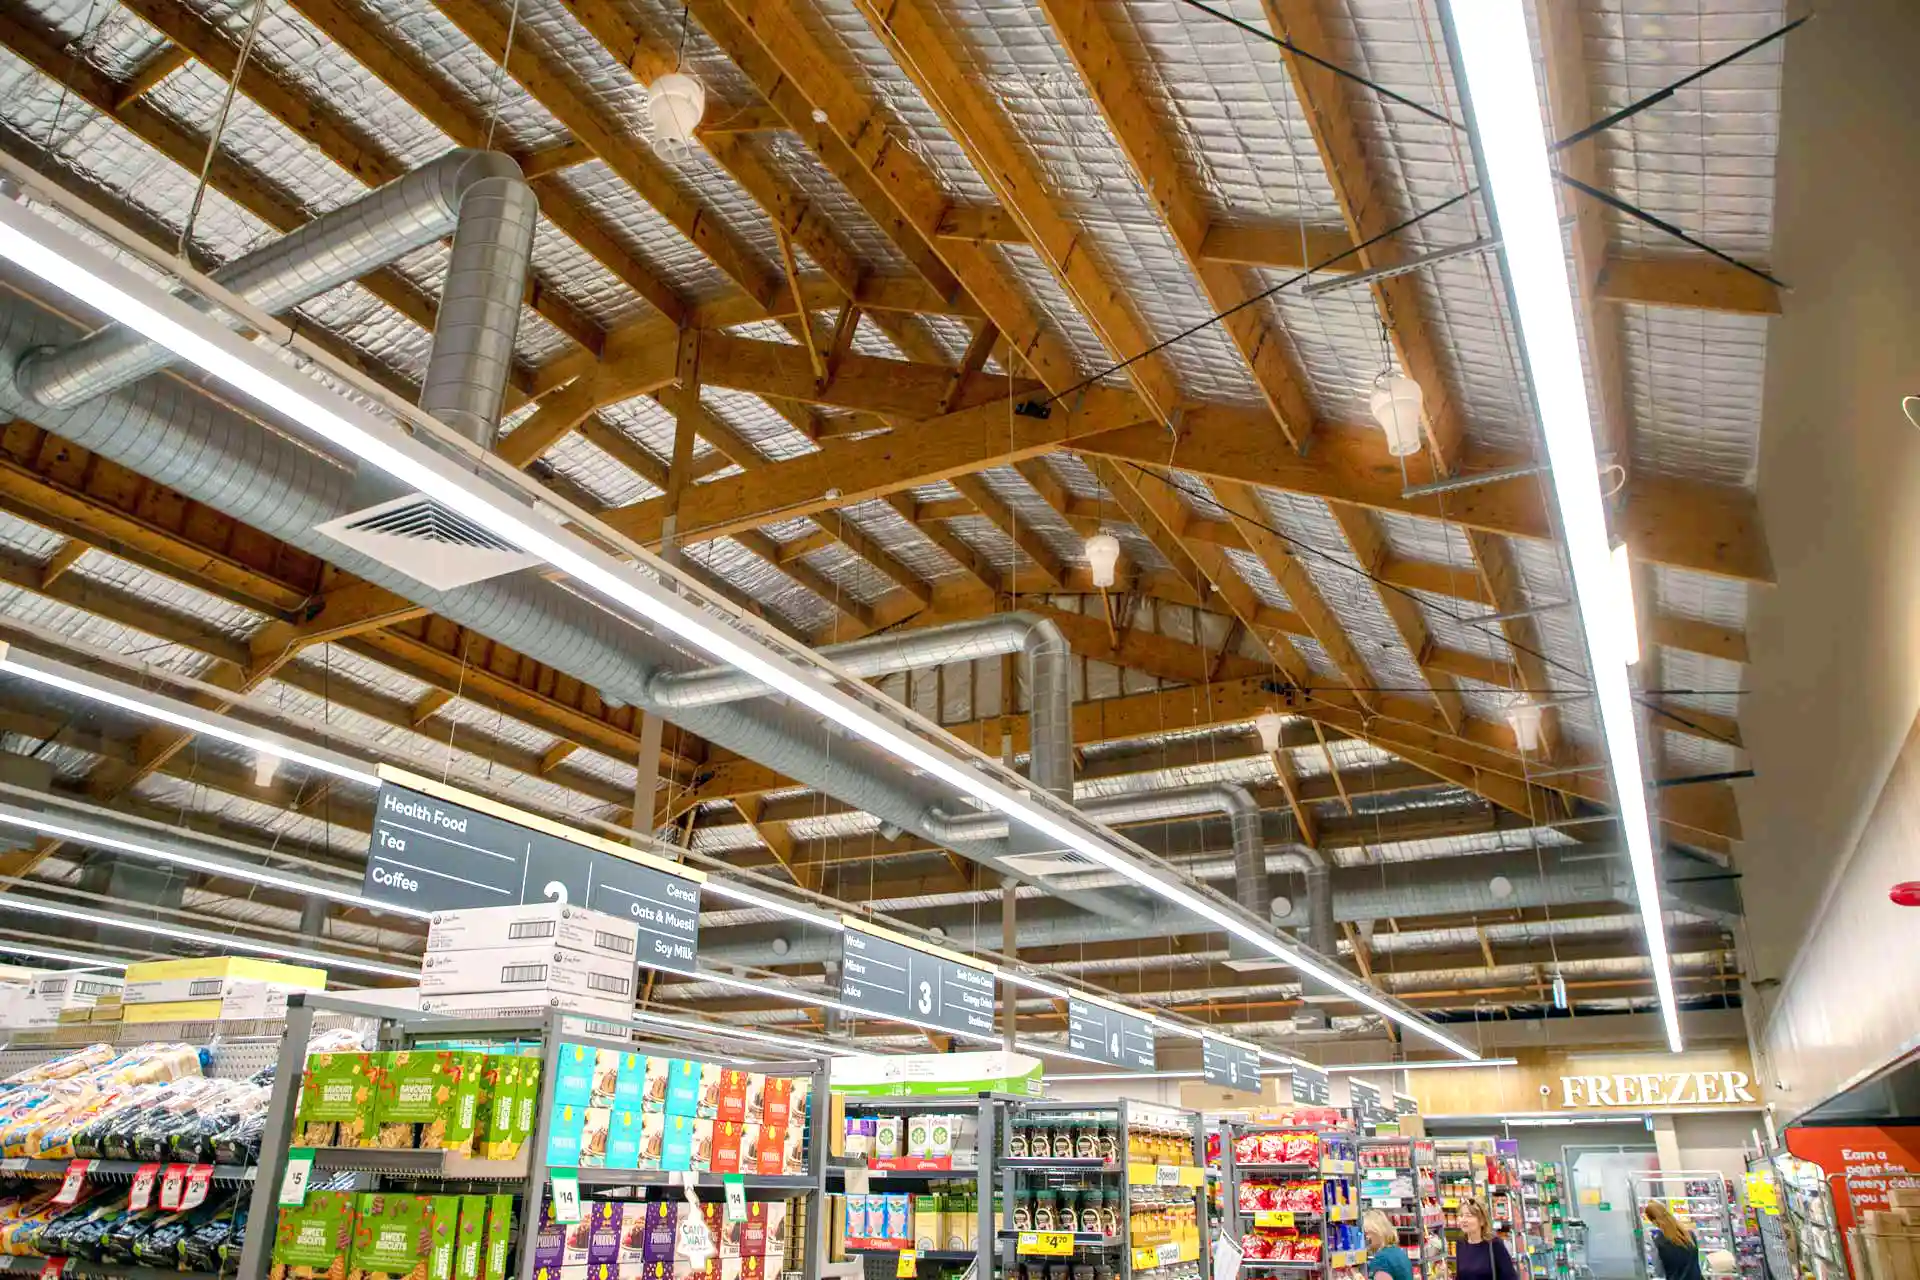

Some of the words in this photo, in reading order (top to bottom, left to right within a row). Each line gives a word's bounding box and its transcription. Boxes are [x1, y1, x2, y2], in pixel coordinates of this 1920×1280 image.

[384, 794, 431, 823] Health
[433, 809, 467, 833] Food
[379, 829, 406, 852] Tea
[372, 867, 419, 892] Coffee
[666, 883, 697, 904] Cereal
[630, 902, 655, 921] Oats
[655, 909, 663, 924] &
[665, 911, 695, 932] Muesli
[846, 934, 866, 949] Water
[654, 939, 673, 959] Soy
[674, 944, 693, 960] Milk
[843, 984, 862, 998] Juice
[918, 981, 932, 1015] 3
[1110, 1032, 1119, 1058] 4
[1559, 1071, 1756, 1108] FREEZER
[1840, 1149, 1875, 1161] Earn
[1877, 1151, 1887, 1160] a
[1845, 1163, 1881, 1176] point
[292, 1172, 303, 1185] $5
[1848, 1179, 1887, 1191] every
[559, 1191, 573, 1204] $14
[730, 1193, 741, 1204] $14
[1851, 1194, 1877, 1206] you
[536, 1234, 561, 1248] PUDDING
[592, 1234, 616, 1247] PUDDING
